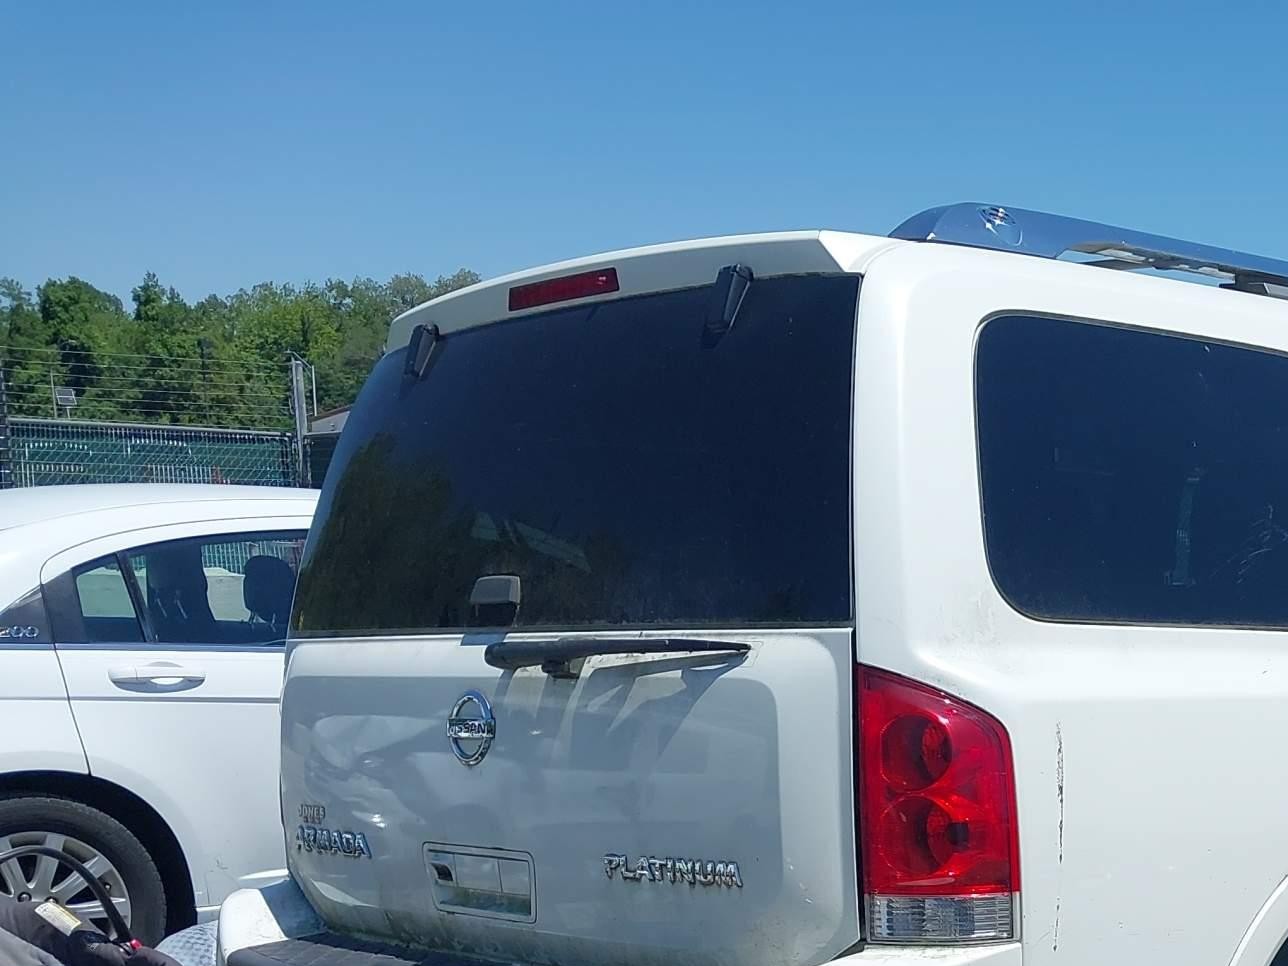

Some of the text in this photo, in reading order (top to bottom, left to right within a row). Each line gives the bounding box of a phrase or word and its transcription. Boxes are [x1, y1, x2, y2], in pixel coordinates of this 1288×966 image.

[0, 625, 39, 638] 200
[296, 825, 372, 859] ARMADA
[602, 853, 743, 888] PLATINUM
